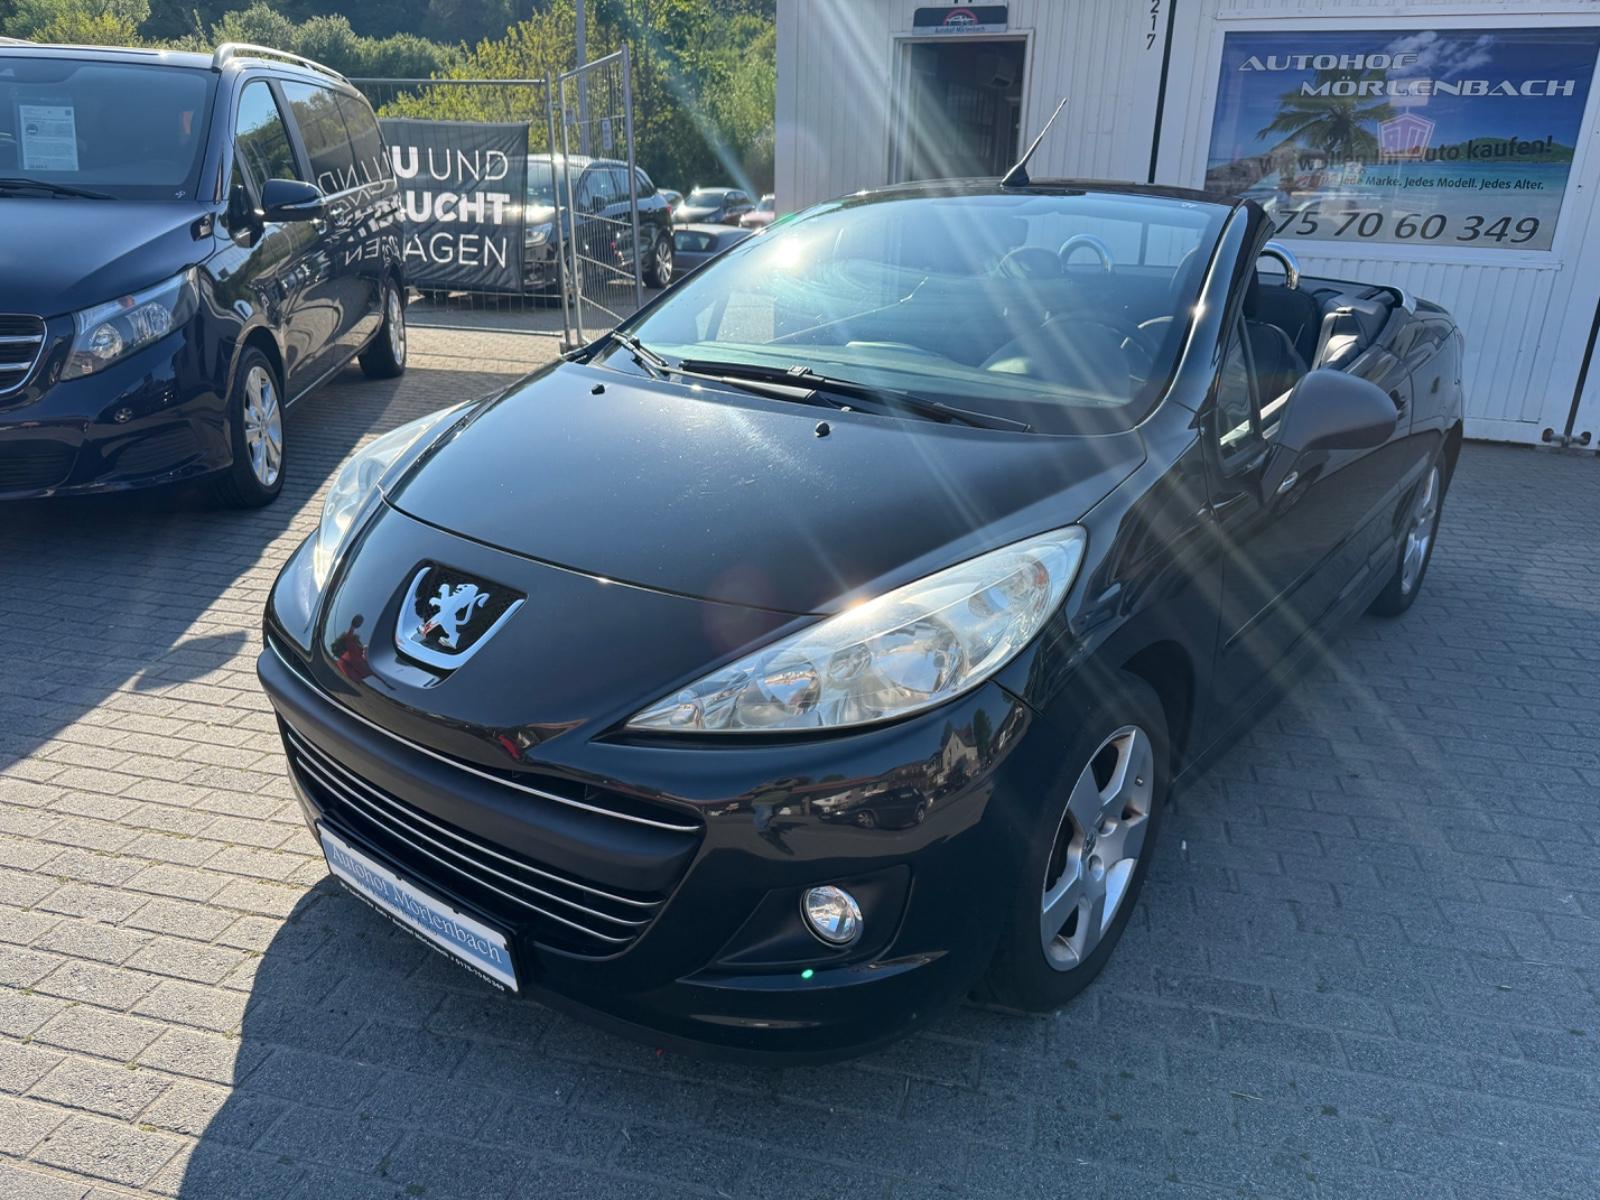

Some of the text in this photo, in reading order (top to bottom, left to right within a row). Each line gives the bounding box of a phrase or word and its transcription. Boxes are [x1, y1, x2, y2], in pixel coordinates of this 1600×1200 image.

[1238, 52, 1418, 71] AUTOHOF
[1301, 75, 1576, 97] MÖRLENBACH
[1467, 135, 1554, 158] kaufen!
[428, 147, 509, 181] UND
[1403, 176, 1434, 188] Jedes
[1437, 177, 1478, 189] Modell.
[1479, 178, 1512, 190] Jedes
[1513, 179, 1545, 190] Alter.
[402, 190, 510, 225] UCHT
[1334, 212, 1383, 238] 70
[1394, 213, 1447, 240] 60
[1456, 215, 1540, 243] 349
[333, 844, 389, 897] Autohof
